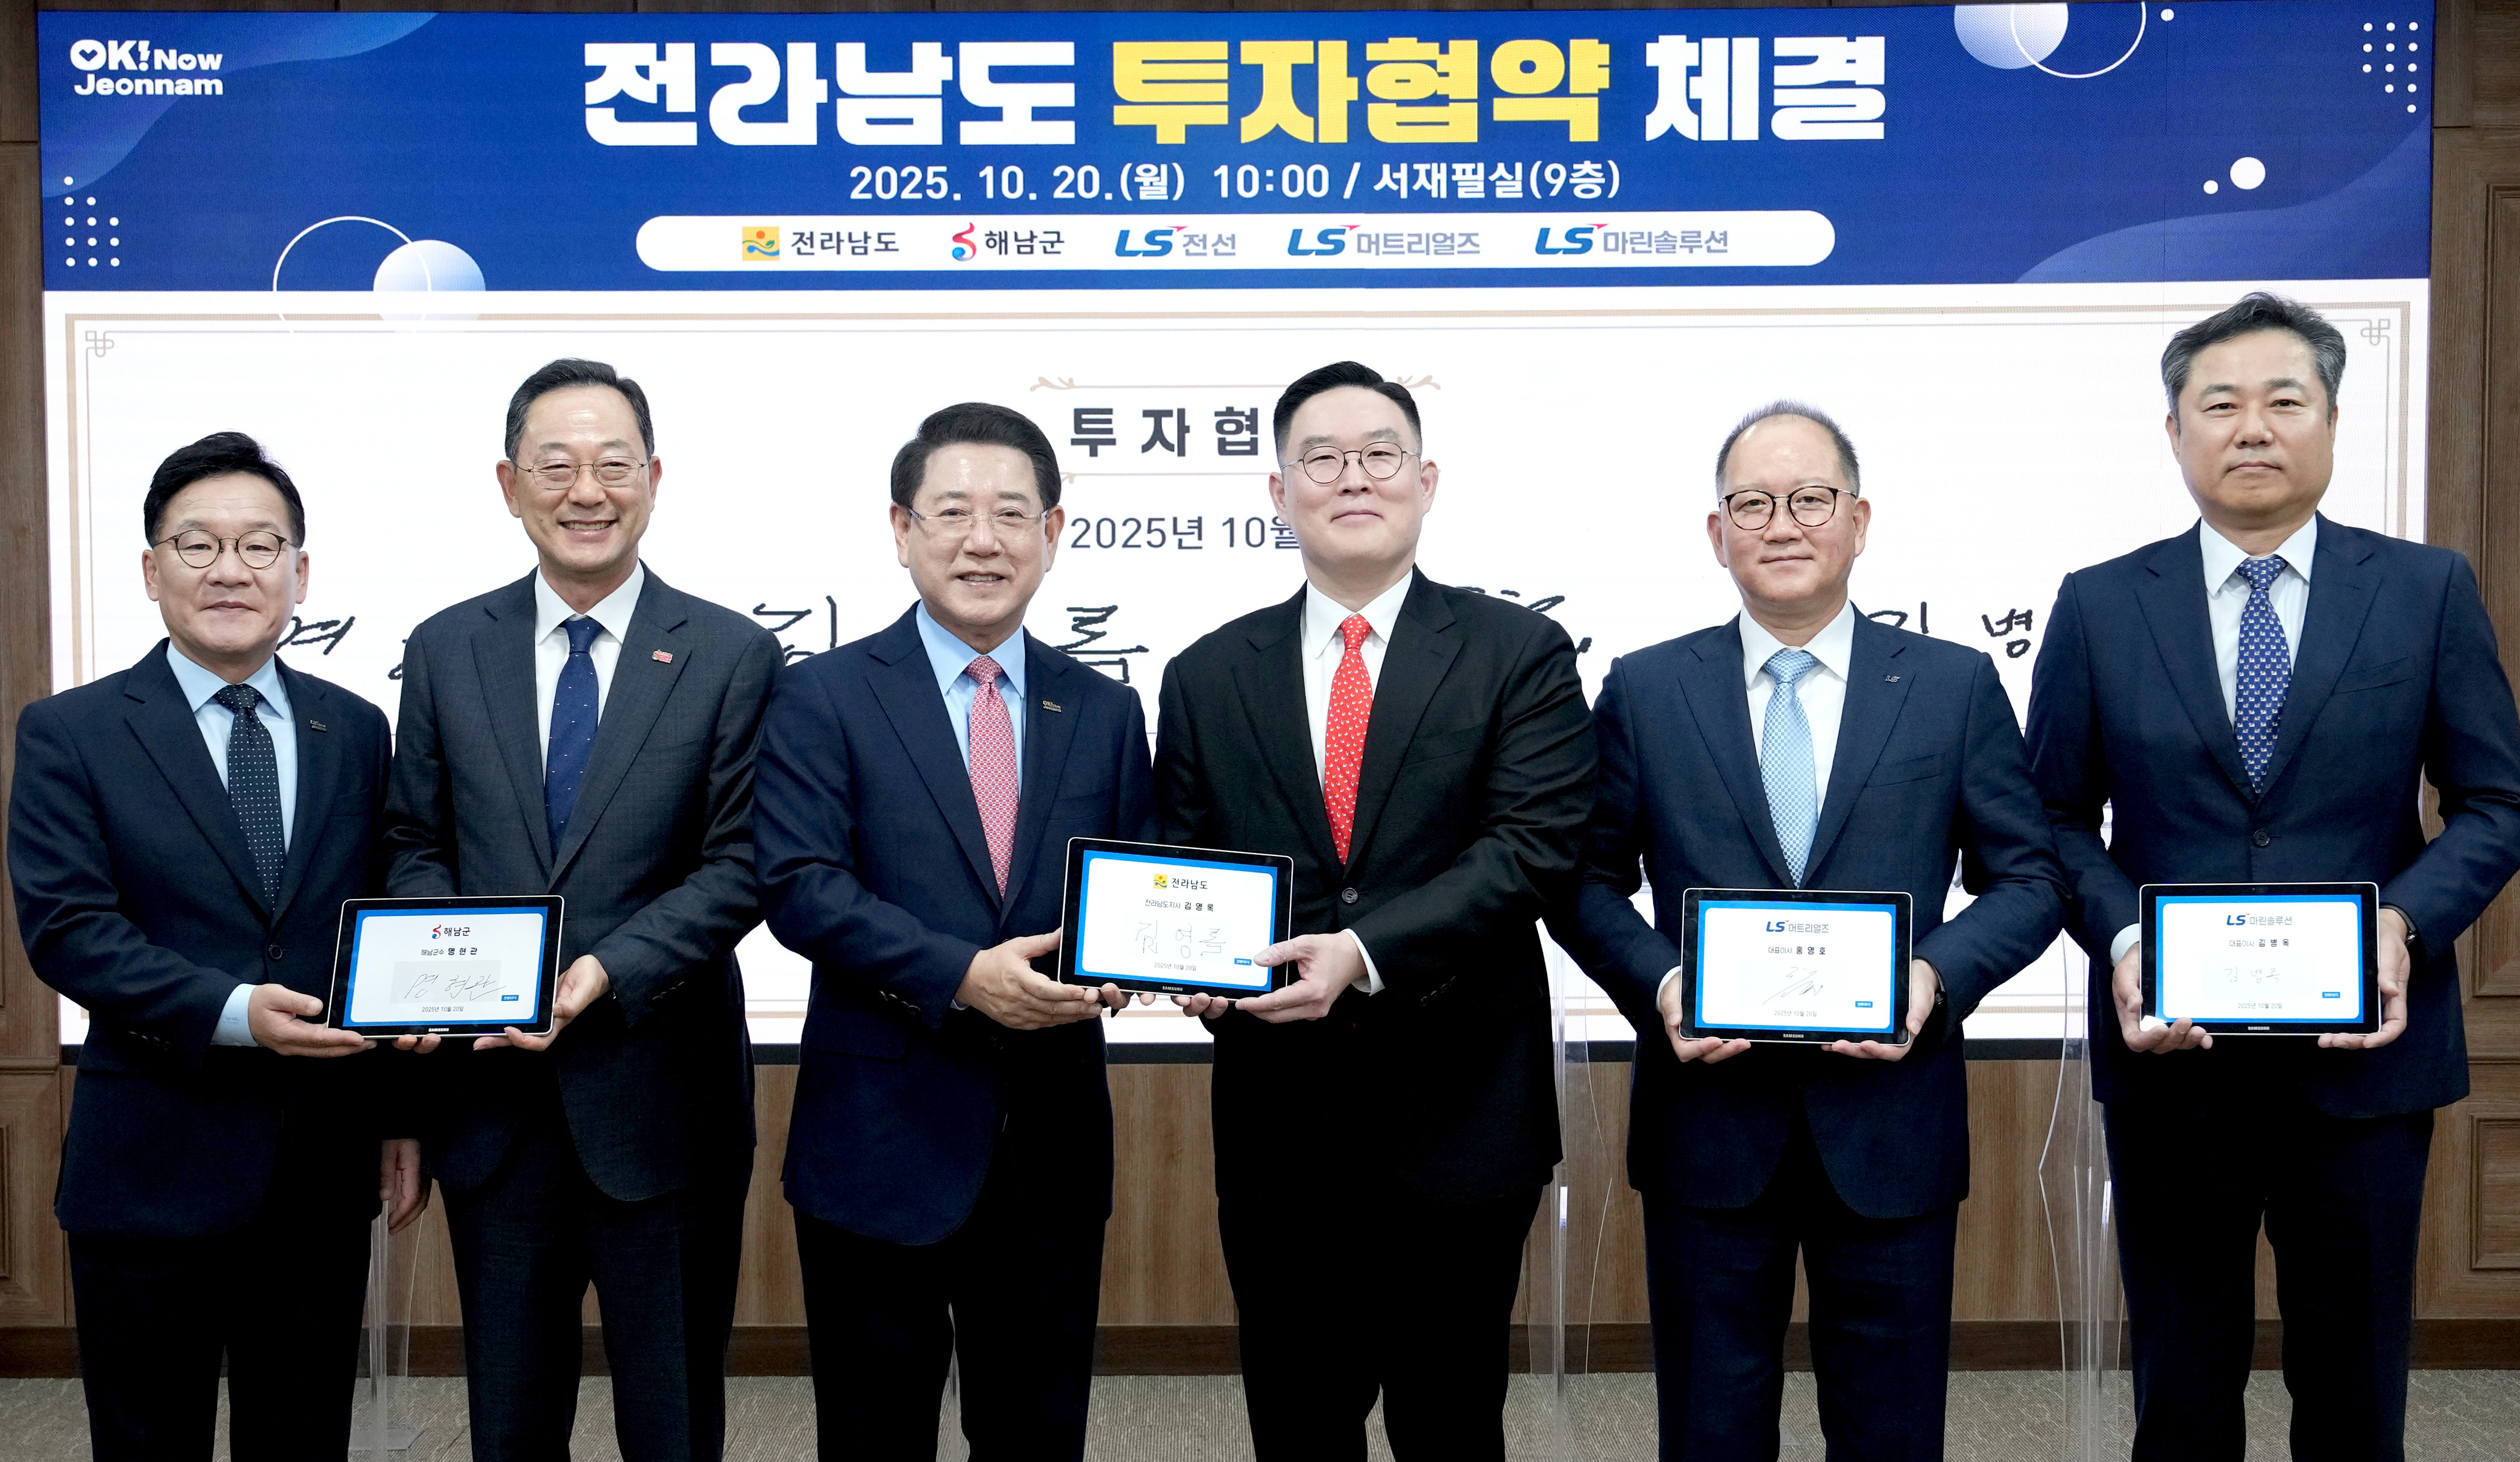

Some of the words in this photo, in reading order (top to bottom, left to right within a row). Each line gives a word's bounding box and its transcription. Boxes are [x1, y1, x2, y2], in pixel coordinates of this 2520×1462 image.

[70, 39, 150, 71] OK!
[154, 49, 222, 71] Now
[74, 74, 223, 95] Jeonnam
[585, 42, 1075, 146] 전라남도
[1113, 37, 1609, 144] 투자협약
[1645, 35, 1885, 141] 체결
[850, 165, 961, 201] 2025.
[979, 165, 1037, 200] 10.
[1213, 164, 1329, 198] 10:00
[1343, 162, 1361, 199] /
[1373, 160, 1620, 199] 서재필실(9층)
[791, 231, 899, 256] 전라남도
[984, 230, 1065, 256] 해남군
[1183, 233, 1236, 257] 전선
[1357, 232, 1480, 256] 머트리얼즈
[1603, 230, 1728, 254] 마린솔루션
[1070, 516, 1203, 550] 2025년
[1171, 878, 1208, 890] 전라남도
[1145, 899, 1181, 909] 전라남도지사
[444, 927, 471, 937] 해남군
[1766, 921, 1785, 932] LS
[1788, 924, 1829, 933] 머트리얼즈
[2226, 915, 2246, 925] LS
[2249, 916, 2292, 925] 마린솔루션
